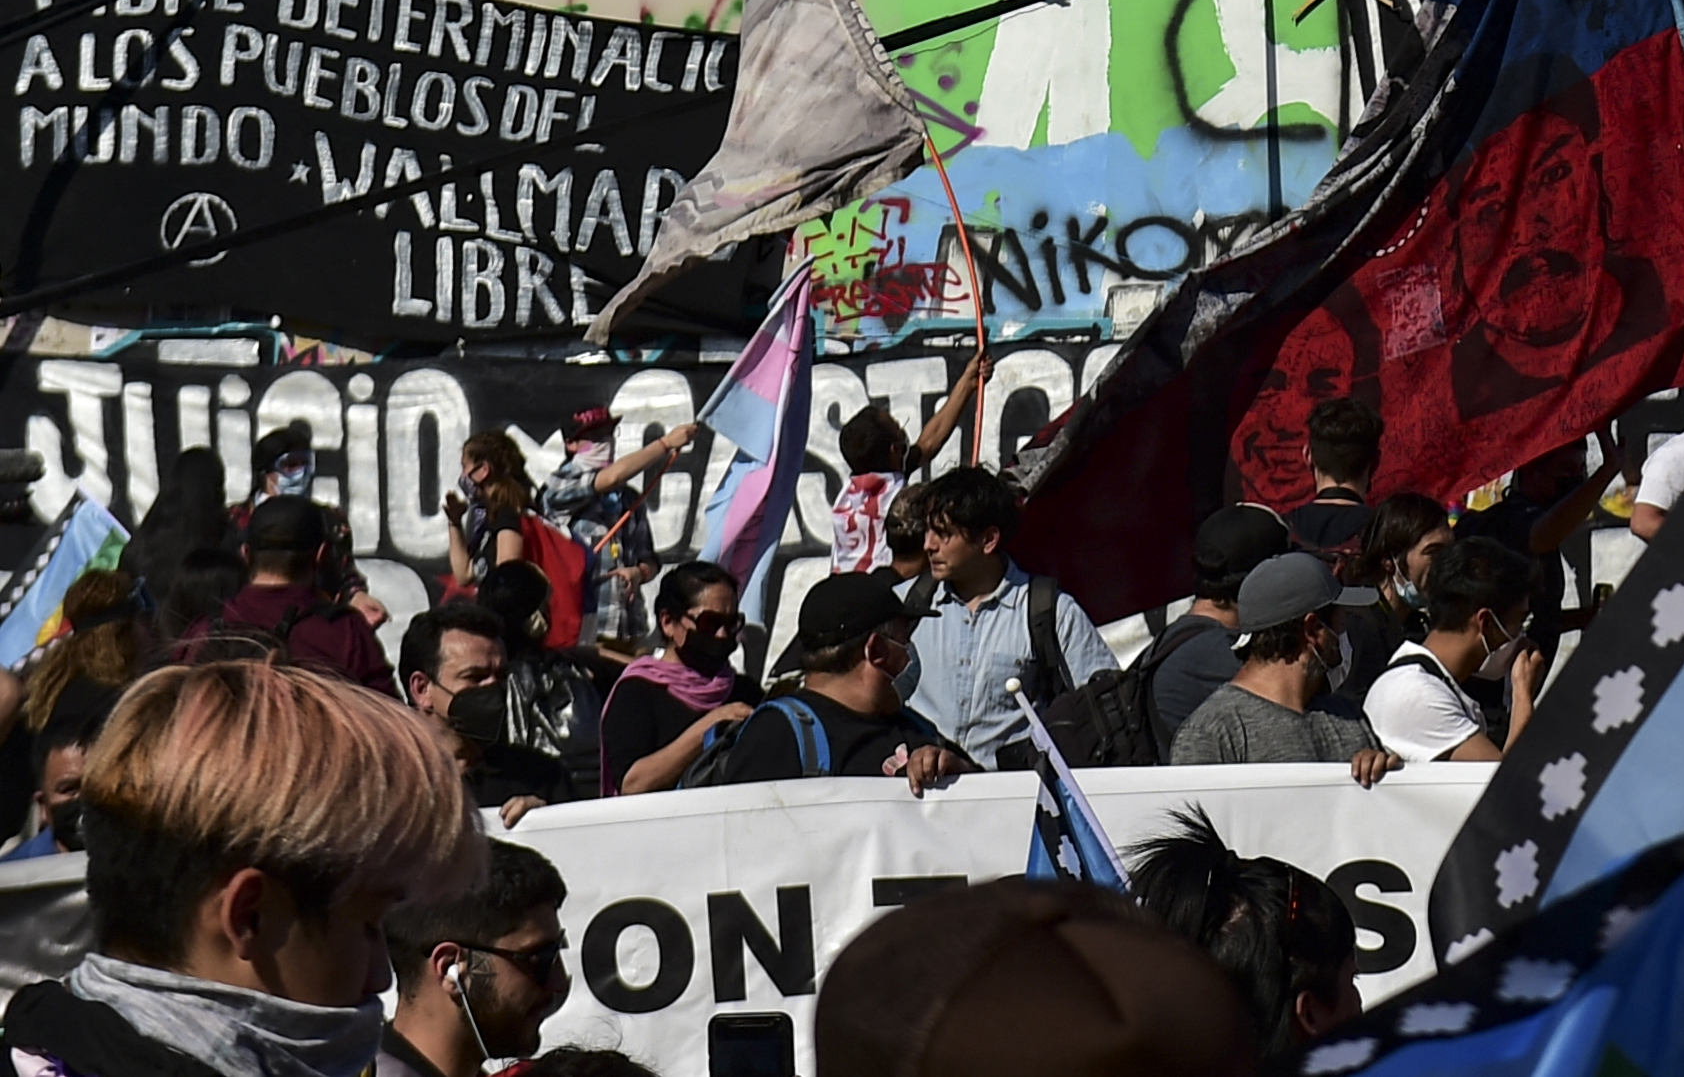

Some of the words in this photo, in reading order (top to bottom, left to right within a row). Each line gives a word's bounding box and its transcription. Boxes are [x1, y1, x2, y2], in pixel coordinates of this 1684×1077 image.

[14, 33, 63, 95] A
[78, 28, 200, 91] LOS
[218, 23, 495, 137] PUEBLOS
[18, 104, 276, 169] MUNDO
[313, 130, 735, 261] WALLMAP
[392, 231, 600, 327] LIBRE
[562, 885, 816, 1014] ON
